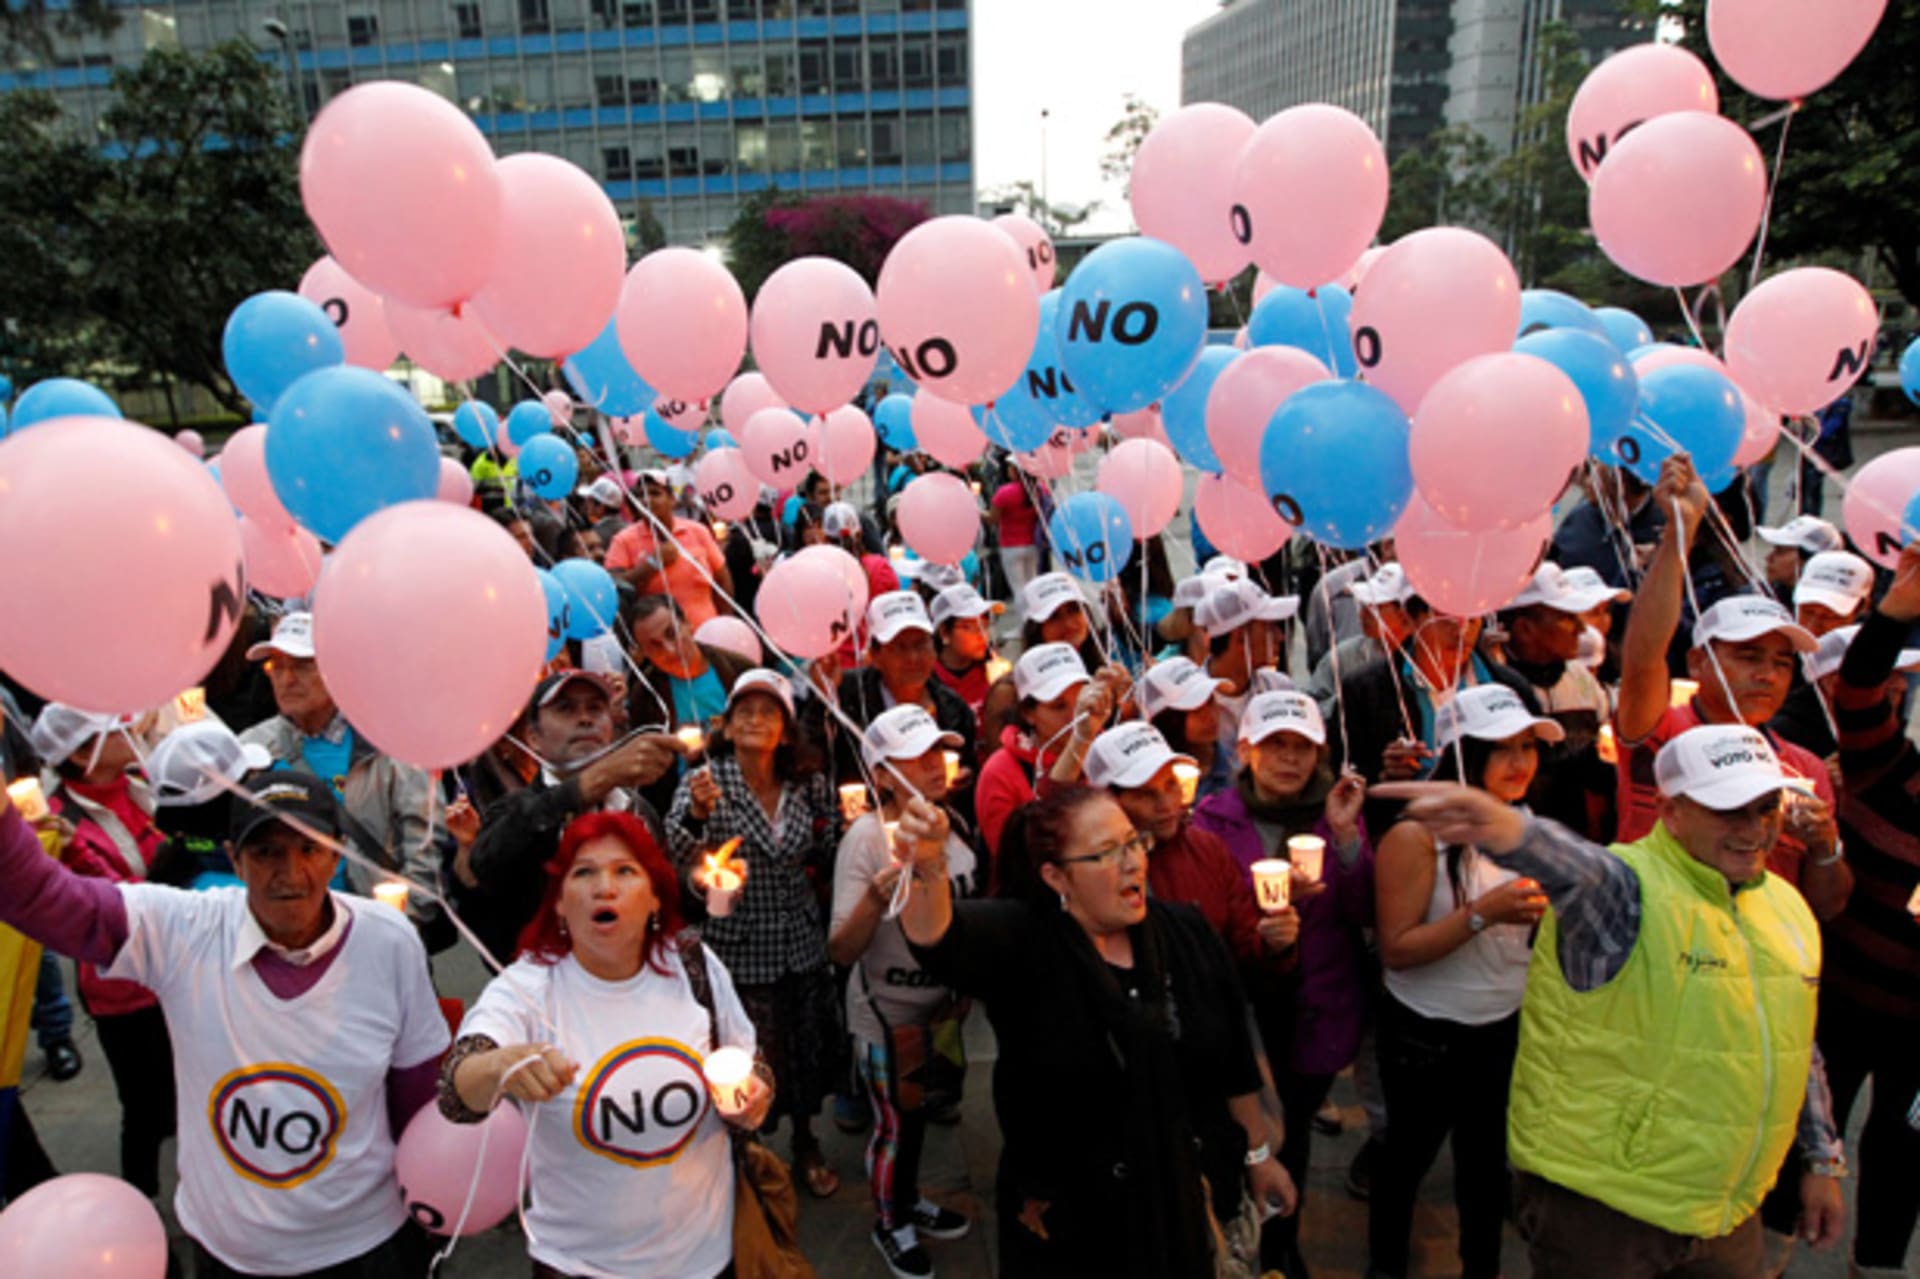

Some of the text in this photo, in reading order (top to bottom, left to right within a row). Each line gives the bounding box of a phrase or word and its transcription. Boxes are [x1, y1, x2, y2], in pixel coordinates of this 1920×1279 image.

[1577, 118, 1650, 171] N
[815, 319, 879, 359] NO
[1067, 299, 1159, 346] NO
[771, 440, 808, 472] NO
[703, 483, 734, 508] NO
[1063, 541, 1106, 569] NO
[228, 1097, 322, 1155] NO
[600, 1081, 698, 1142] NO
